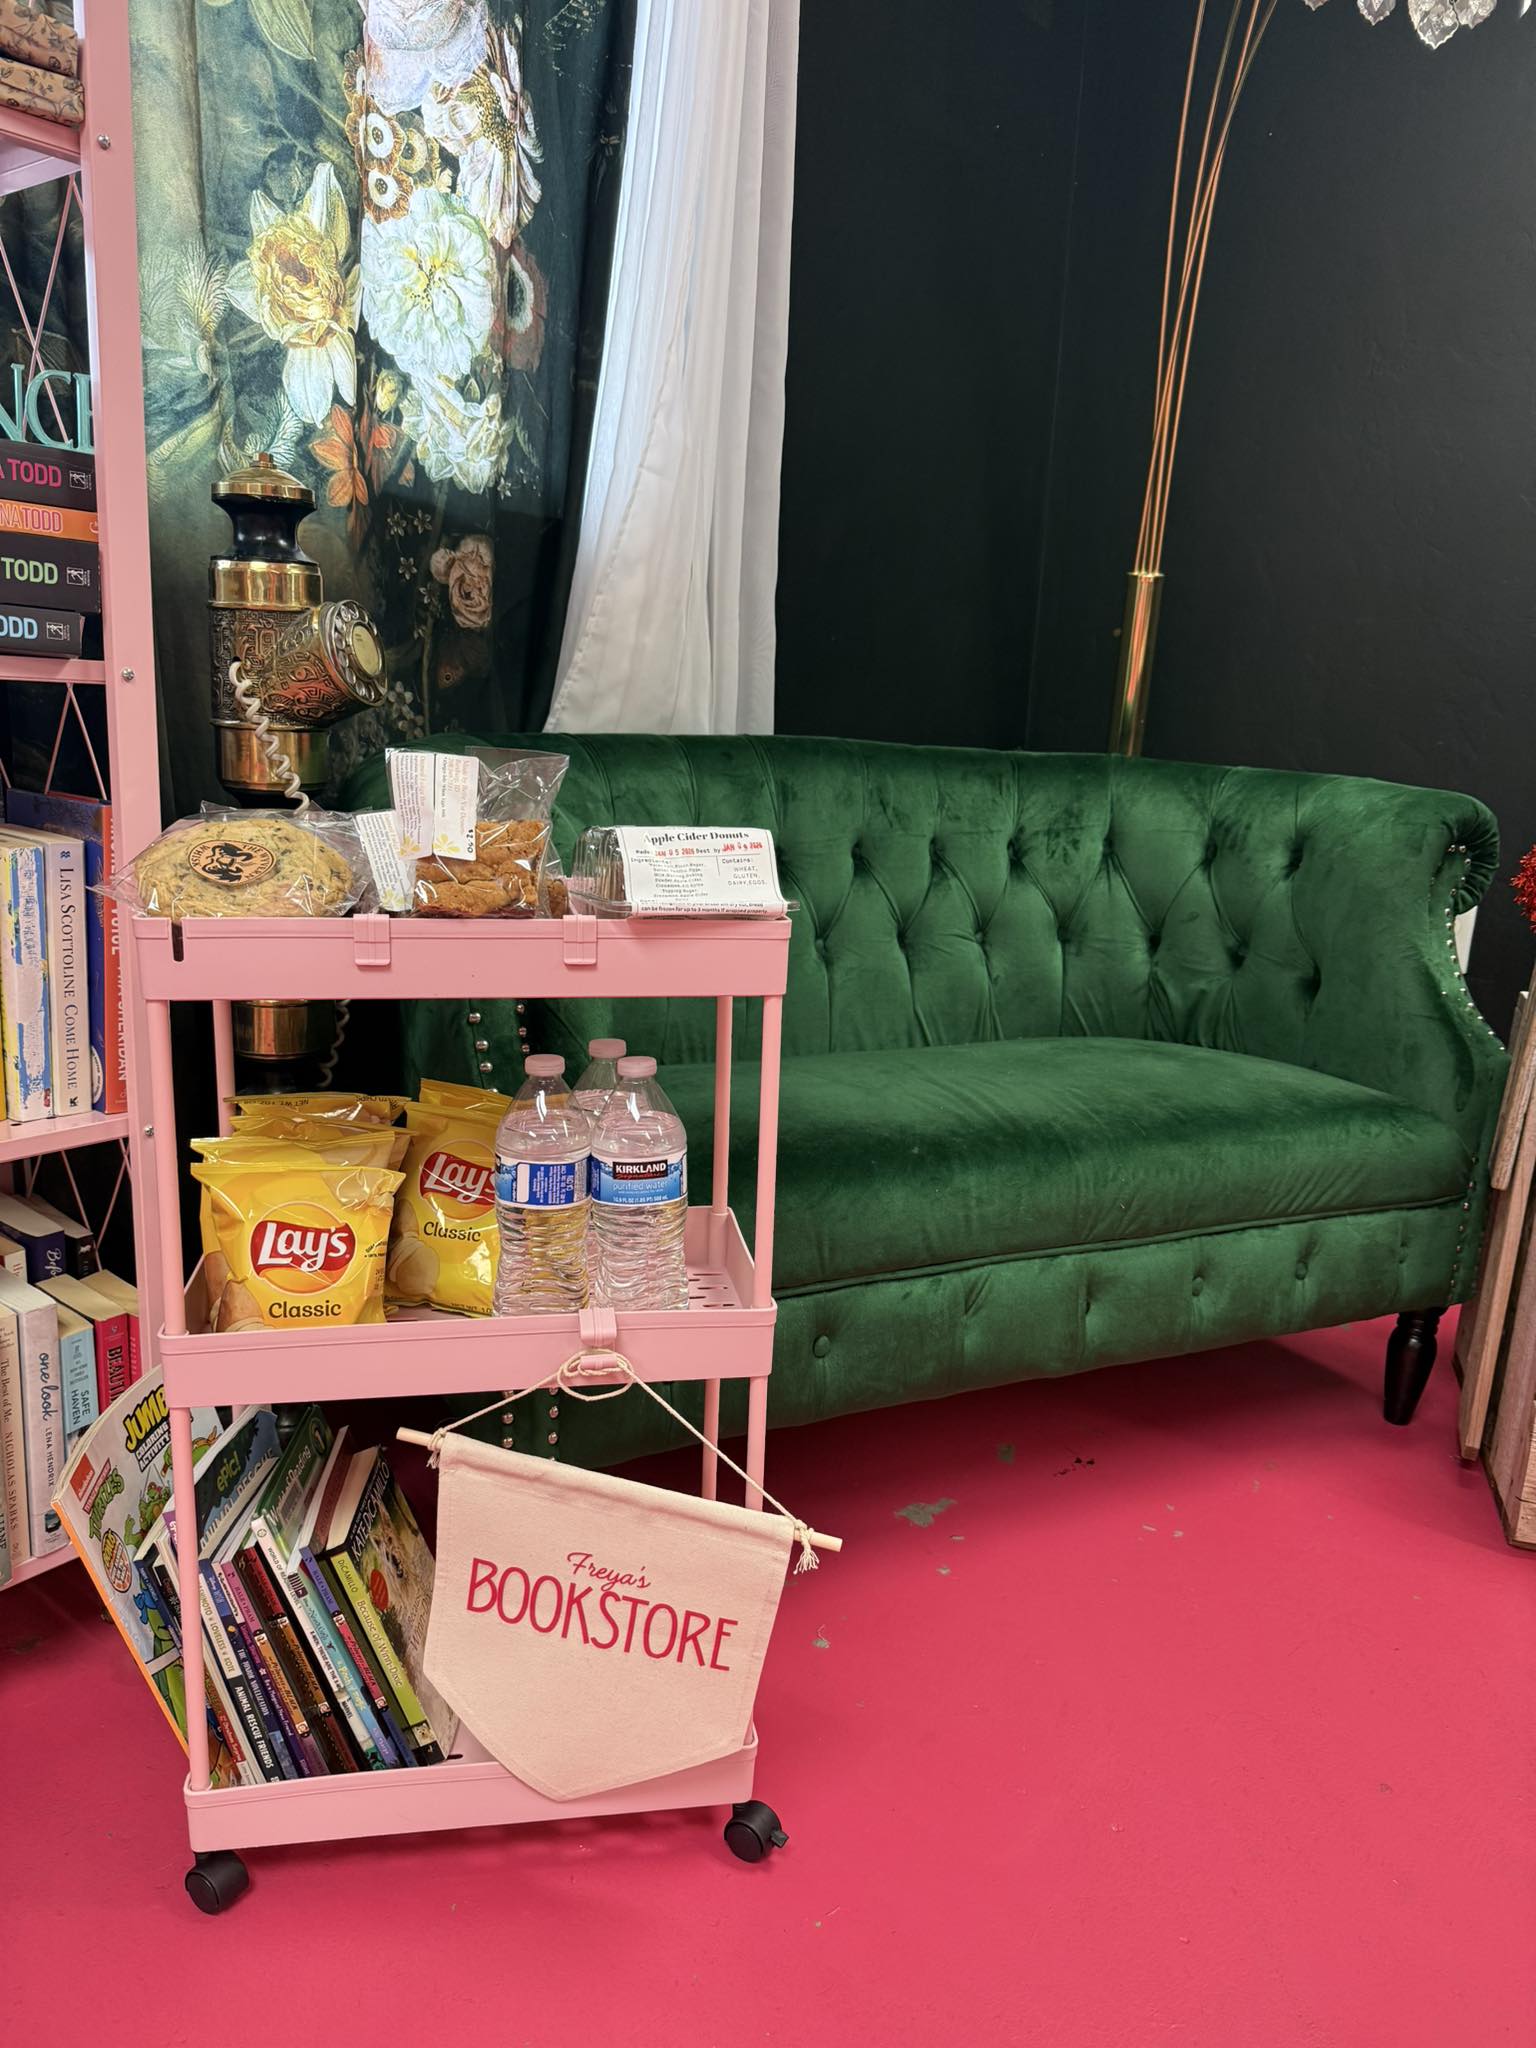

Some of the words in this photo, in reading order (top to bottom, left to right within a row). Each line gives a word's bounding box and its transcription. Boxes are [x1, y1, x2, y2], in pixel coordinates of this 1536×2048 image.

[7, 458, 62, 488] TODD
[22, 507, 63, 534] TODD
[0, 555, 58, 585] TODD
[642, 833, 675, 846] Apple
[677, 832, 708, 841] Cider
[710, 832, 750, 840] Donuts
[722, 842, 735, 851] JAN
[192, 844, 211, 867] WHISK
[64, 1004, 78, 1045] COME
[66, 1048, 80, 1090] HOME
[615, 1162, 667, 1174] KIRKLAND
[612, 1182, 644, 1191] purified
[646, 1181, 668, 1190] water
[256, 1220, 350, 1272] Lay's
[423, 1220, 482, 1243] Classic
[44, 1248, 62, 1278] Befo
[268, 1300, 343, 1320] Classic
[38, 1352, 50, 1384] one
[40, 1384, 59, 1422] look
[71, 1389, 80, 1426] HAVEN
[80, 1390, 91, 1416] SAFE
[123, 1384, 170, 1453] JUMB
[46, 1427, 54, 1450] LENA
[136, 1421, 170, 1461] COLORING
[138, 1432, 171, 1473] ACTIVITY
[5, 1431, 16, 1487] NICHOLAS
[46, 1450, 55, 1487] HENDRIX
[216, 1451, 242, 1493] epic!
[7, 1491, 19, 1530] SPARKS
[350, 1514, 370, 1559] KATE
[362, 1461, 390, 1521] DiCAMILLO
[266, 1546, 277, 1560] WORLD
[275, 1563, 283, 1572] OF
[566, 1552, 652, 1592] Freya's
[338, 1559, 358, 1594] DiCAMILLO
[356, 1600, 375, 1631] Because
[372, 1630, 382, 1646] of
[378, 1644, 404, 1688] Winn-Dixie
[466, 1557, 739, 1672] BOOKSTORE
[210, 1622, 227, 1655] LOVELESS
[308, 1630, 320, 1646] X-MEN:
[316, 1645, 328, 1661] THESE
[324, 1660, 333, 1671] ARE
[328, 1670, 338, 1681] THE
[339, 1700, 354, 1719] MARVEL
[234, 1686, 250, 1713] ANIMAL
[246, 1713, 262, 1739] RESCUE
[256, 1736, 274, 1768] FRIENDS
